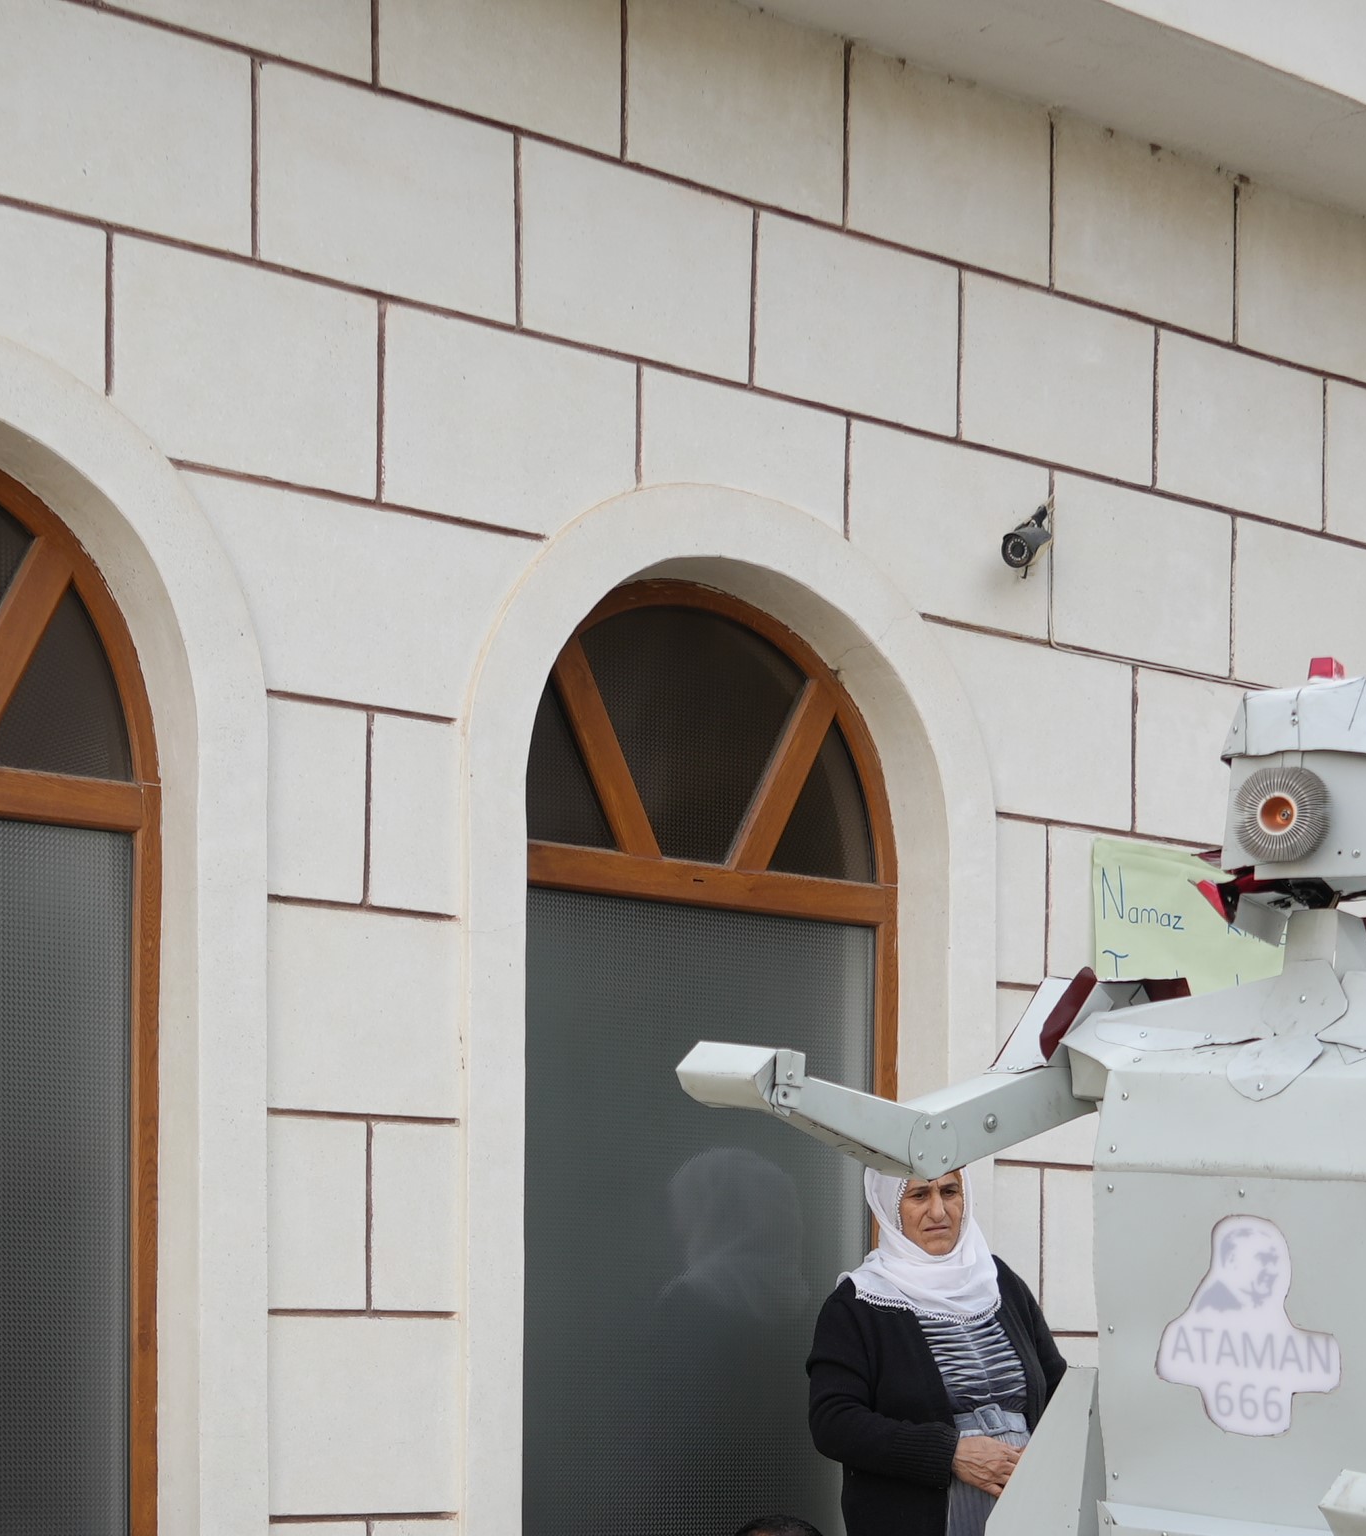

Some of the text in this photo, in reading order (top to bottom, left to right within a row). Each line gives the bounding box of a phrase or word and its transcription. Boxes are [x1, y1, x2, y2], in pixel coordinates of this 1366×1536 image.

[1101, 865, 1184, 930] Namaz
[1171, 1326, 1332, 1374] ATAMAN
[1215, 1381, 1283, 1423] 666
